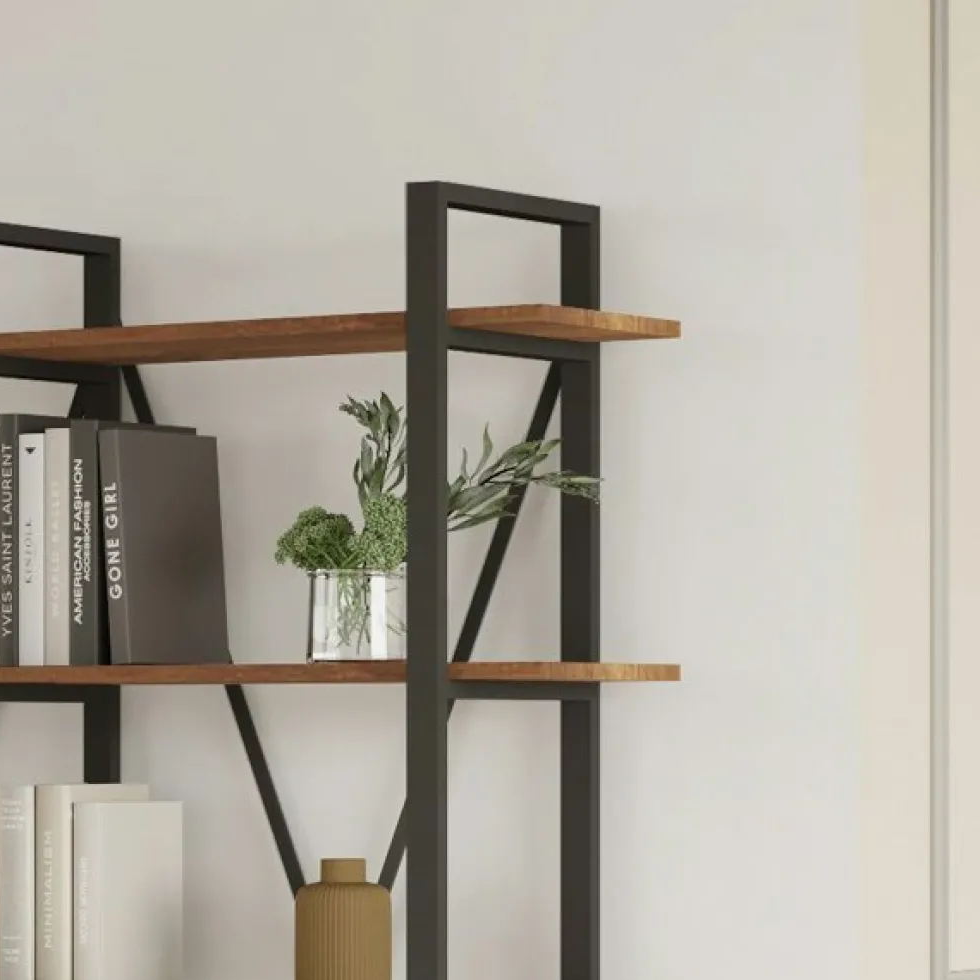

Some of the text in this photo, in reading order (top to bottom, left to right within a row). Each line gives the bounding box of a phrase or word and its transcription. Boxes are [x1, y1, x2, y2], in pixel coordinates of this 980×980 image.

[1, 444, 13, 637] YVES SAINT LAURENT
[73, 458, 83, 625] AMERICAN FASHION
[83, 500, 92, 582] ACCESSORIES
[104, 482, 122, 600] GONE GIRL
